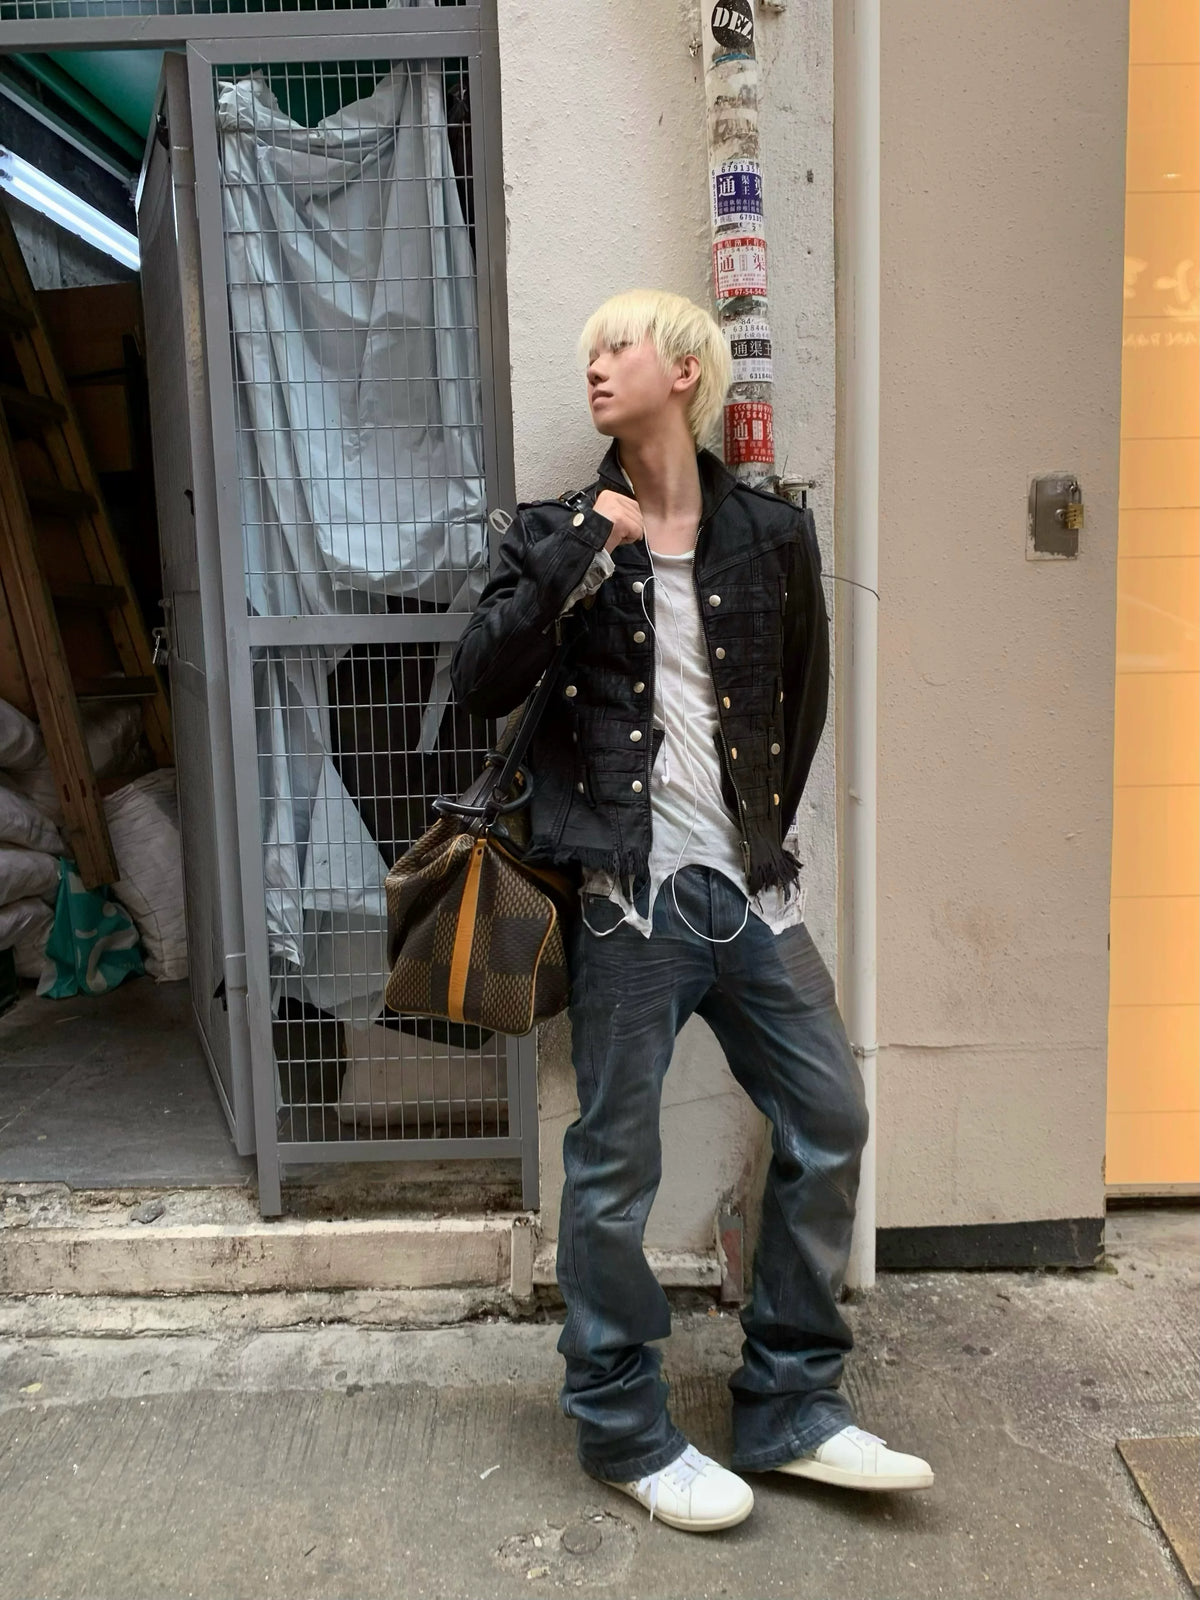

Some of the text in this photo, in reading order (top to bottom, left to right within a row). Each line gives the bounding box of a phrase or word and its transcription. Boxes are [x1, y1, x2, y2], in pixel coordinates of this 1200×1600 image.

[713, 6, 753, 40] DEZ
[718, 175, 736, 197] 通
[719, 254, 735, 273] 通
[753, 253, 766, 272] 渠
[733, 340, 771, 357] 通渠王
[733, 418, 749, 440] 通
